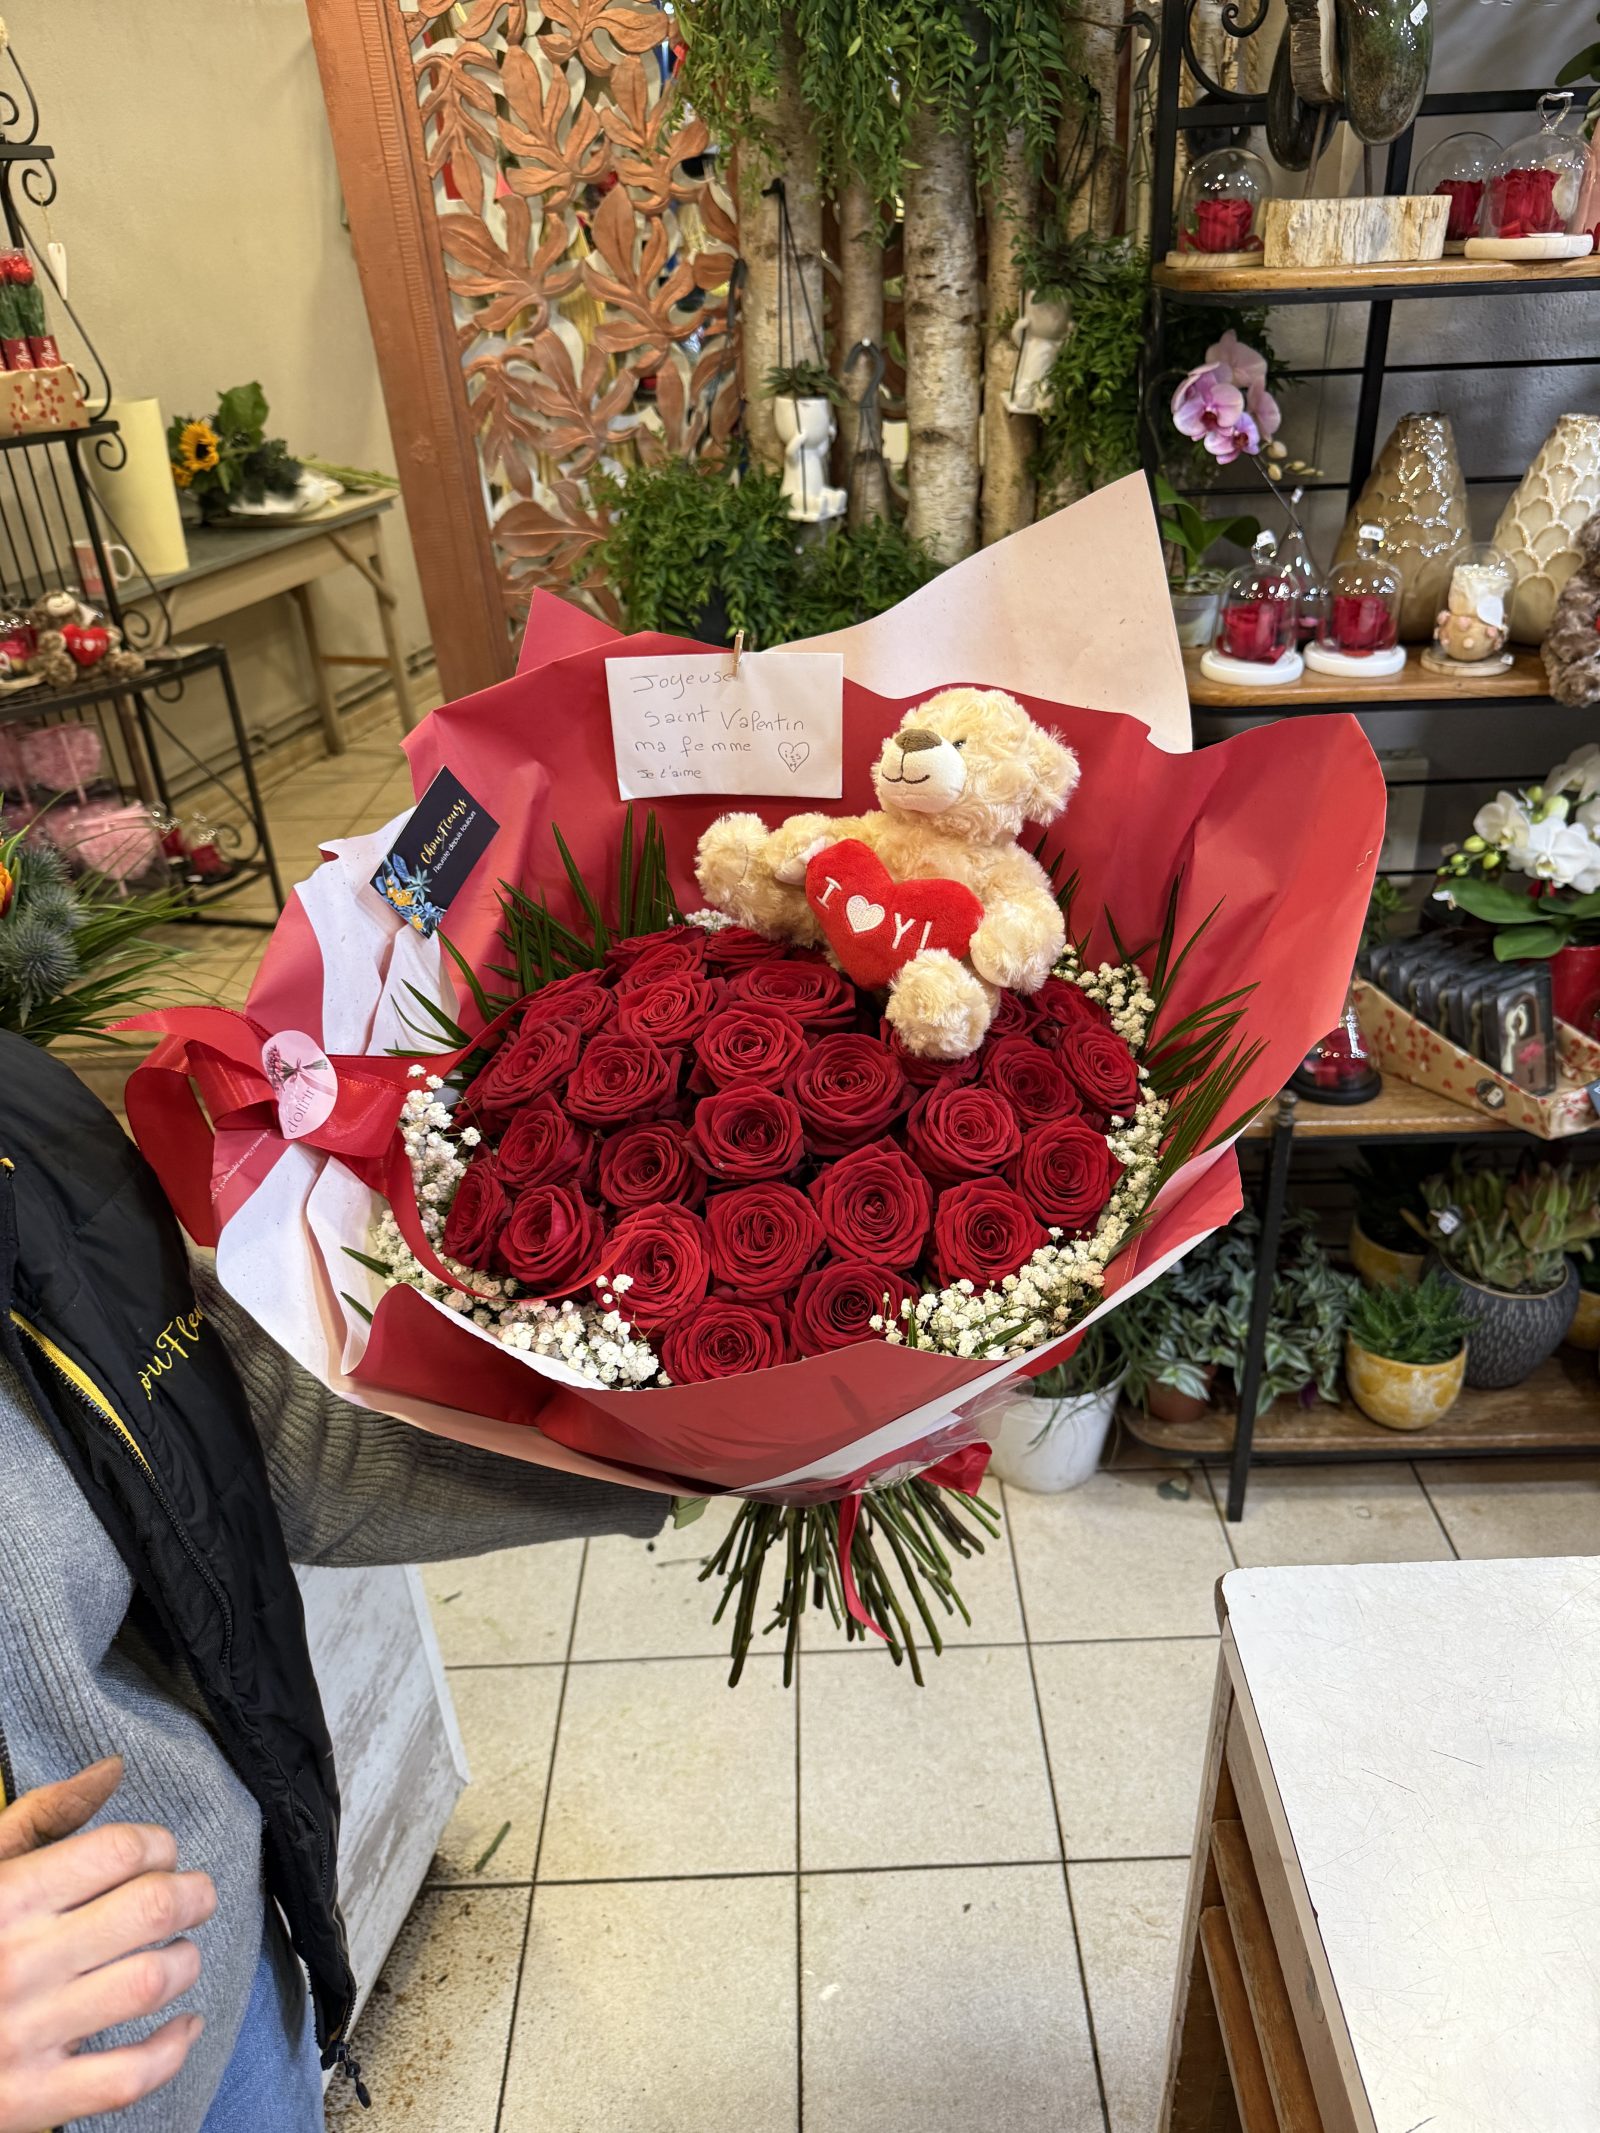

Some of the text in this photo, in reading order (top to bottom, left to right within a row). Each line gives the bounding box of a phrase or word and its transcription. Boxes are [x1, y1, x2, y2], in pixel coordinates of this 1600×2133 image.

[630, 671, 737, 700] Joyeuse
[644, 704, 805, 732] Saint Valentin
[635, 736, 752, 758] ma femme
[637, 769, 656, 780] Je
[816, 876, 842, 910] I
